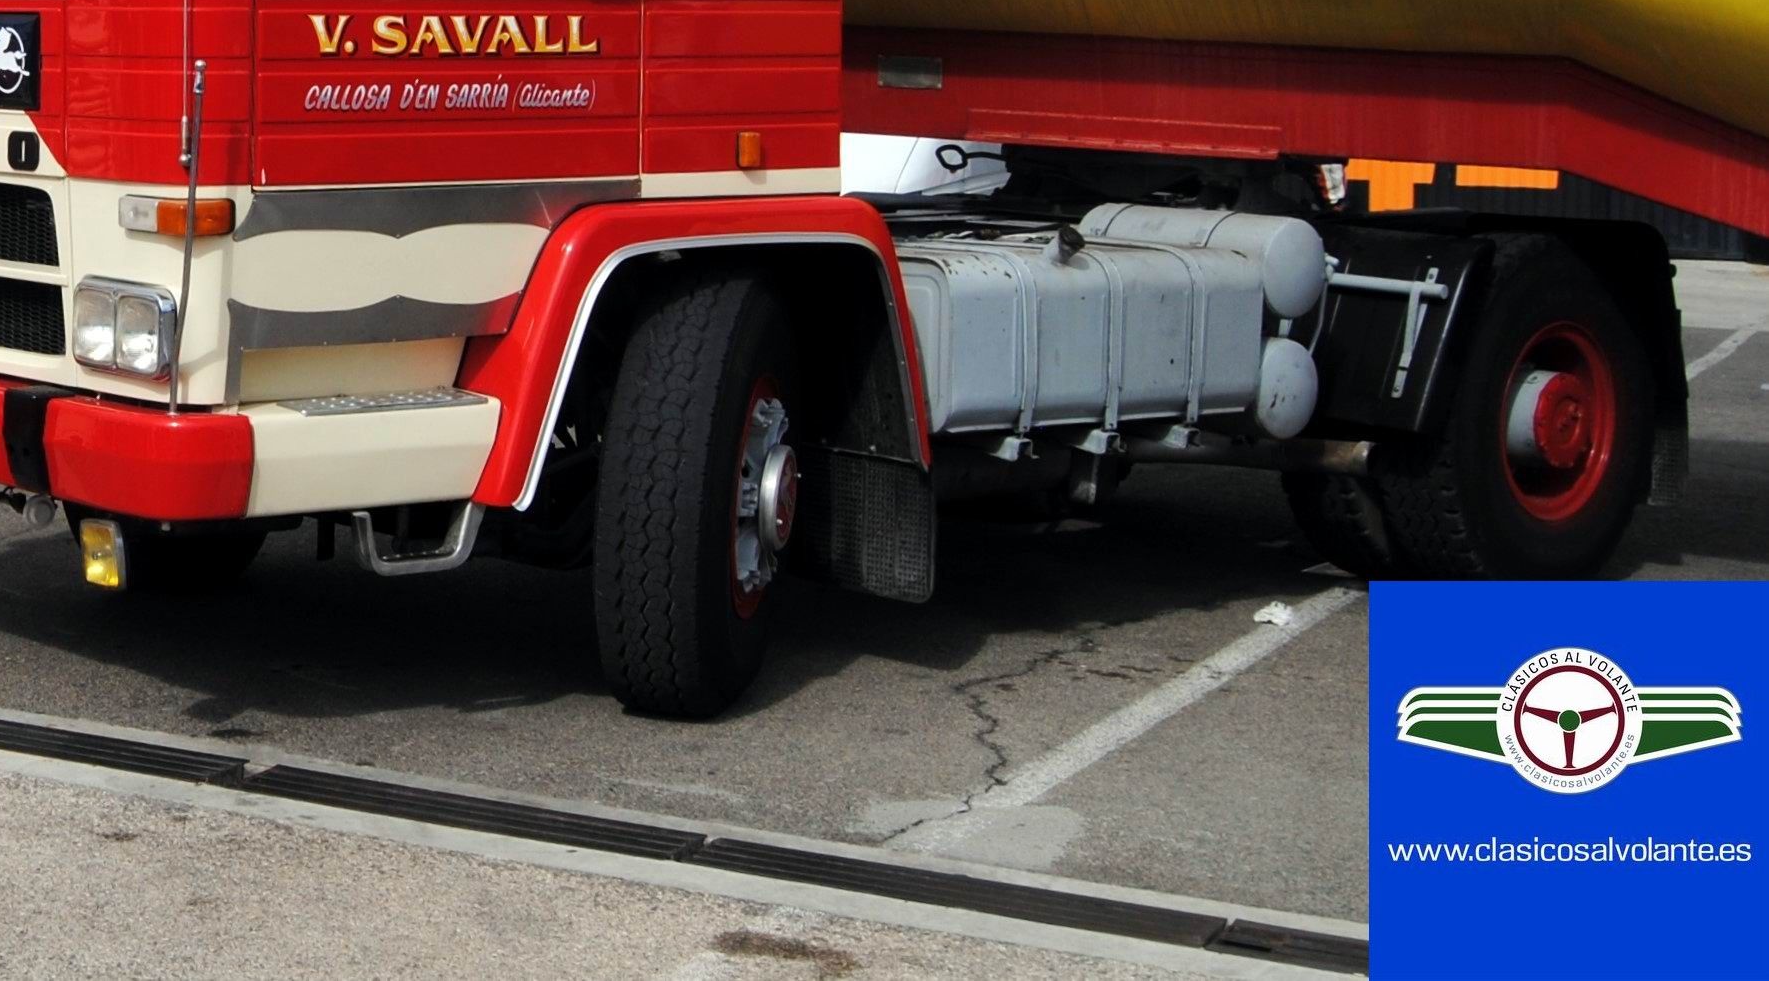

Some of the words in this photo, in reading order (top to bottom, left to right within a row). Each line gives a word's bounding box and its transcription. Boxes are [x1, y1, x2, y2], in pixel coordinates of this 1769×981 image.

[307, 14, 356, 55] V.
[371, 14, 600, 55] SAVALL
[304, 83, 391, 110] CALLOSA
[444, 74, 509, 110] SARRÍA
